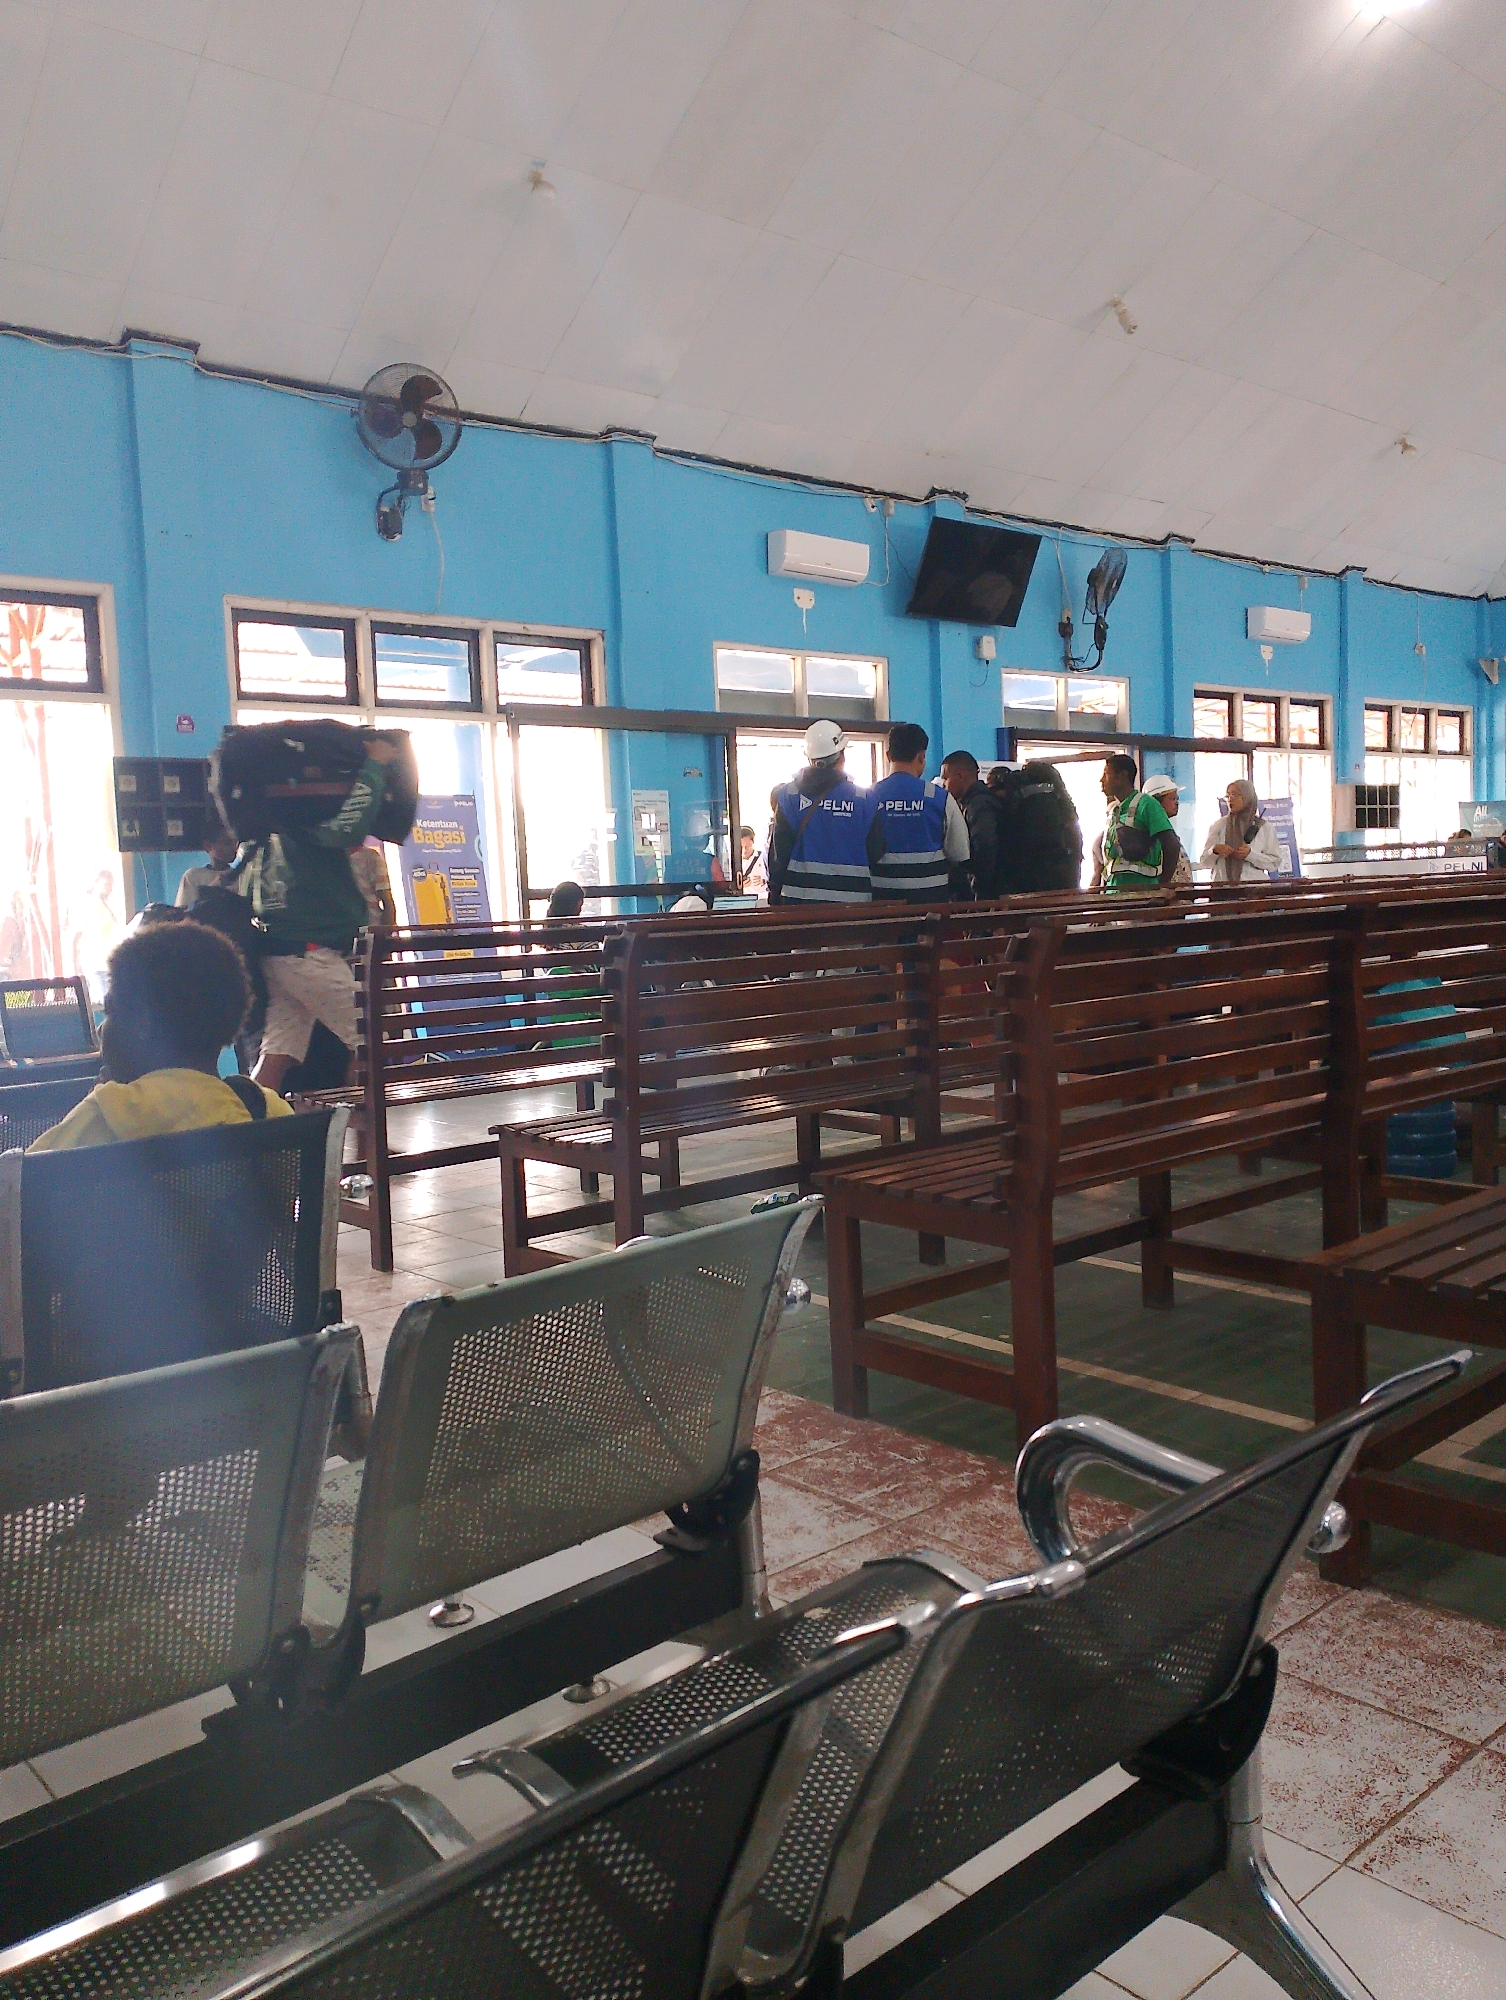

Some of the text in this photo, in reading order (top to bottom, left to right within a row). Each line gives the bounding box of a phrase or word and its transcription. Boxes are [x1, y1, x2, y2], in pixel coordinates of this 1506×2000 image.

[886, 800, 924, 811] PELNI
[416, 819, 458, 828] Ketentuan
[412, 825, 466, 849] Bagasi
[1444, 861, 1483, 871] PELNI
